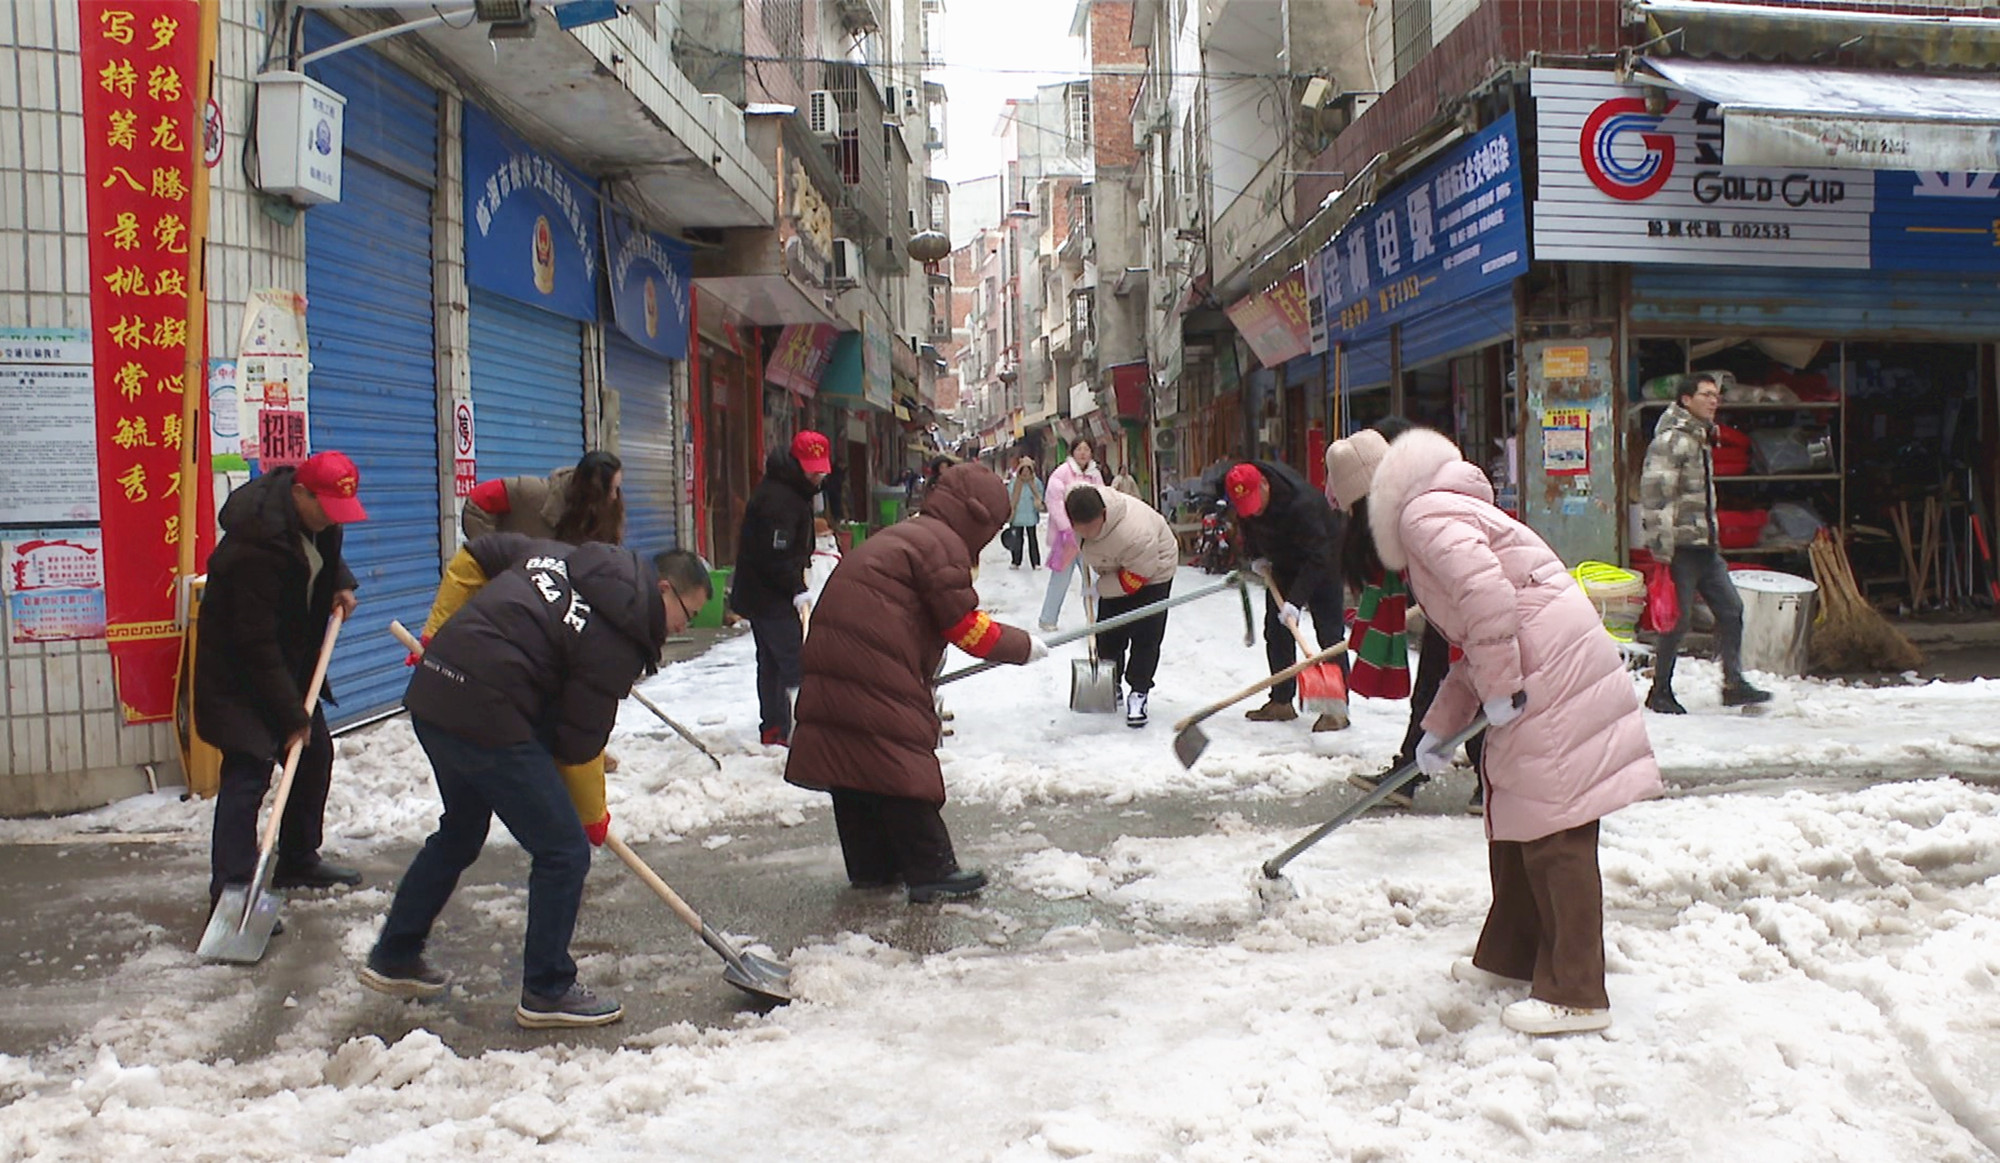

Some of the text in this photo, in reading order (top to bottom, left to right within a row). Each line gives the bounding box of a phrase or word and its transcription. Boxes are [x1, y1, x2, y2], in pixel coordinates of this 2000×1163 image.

[1647, 220, 1791, 240] 股票代码 002533
[262, 413, 304, 459] 招聘
